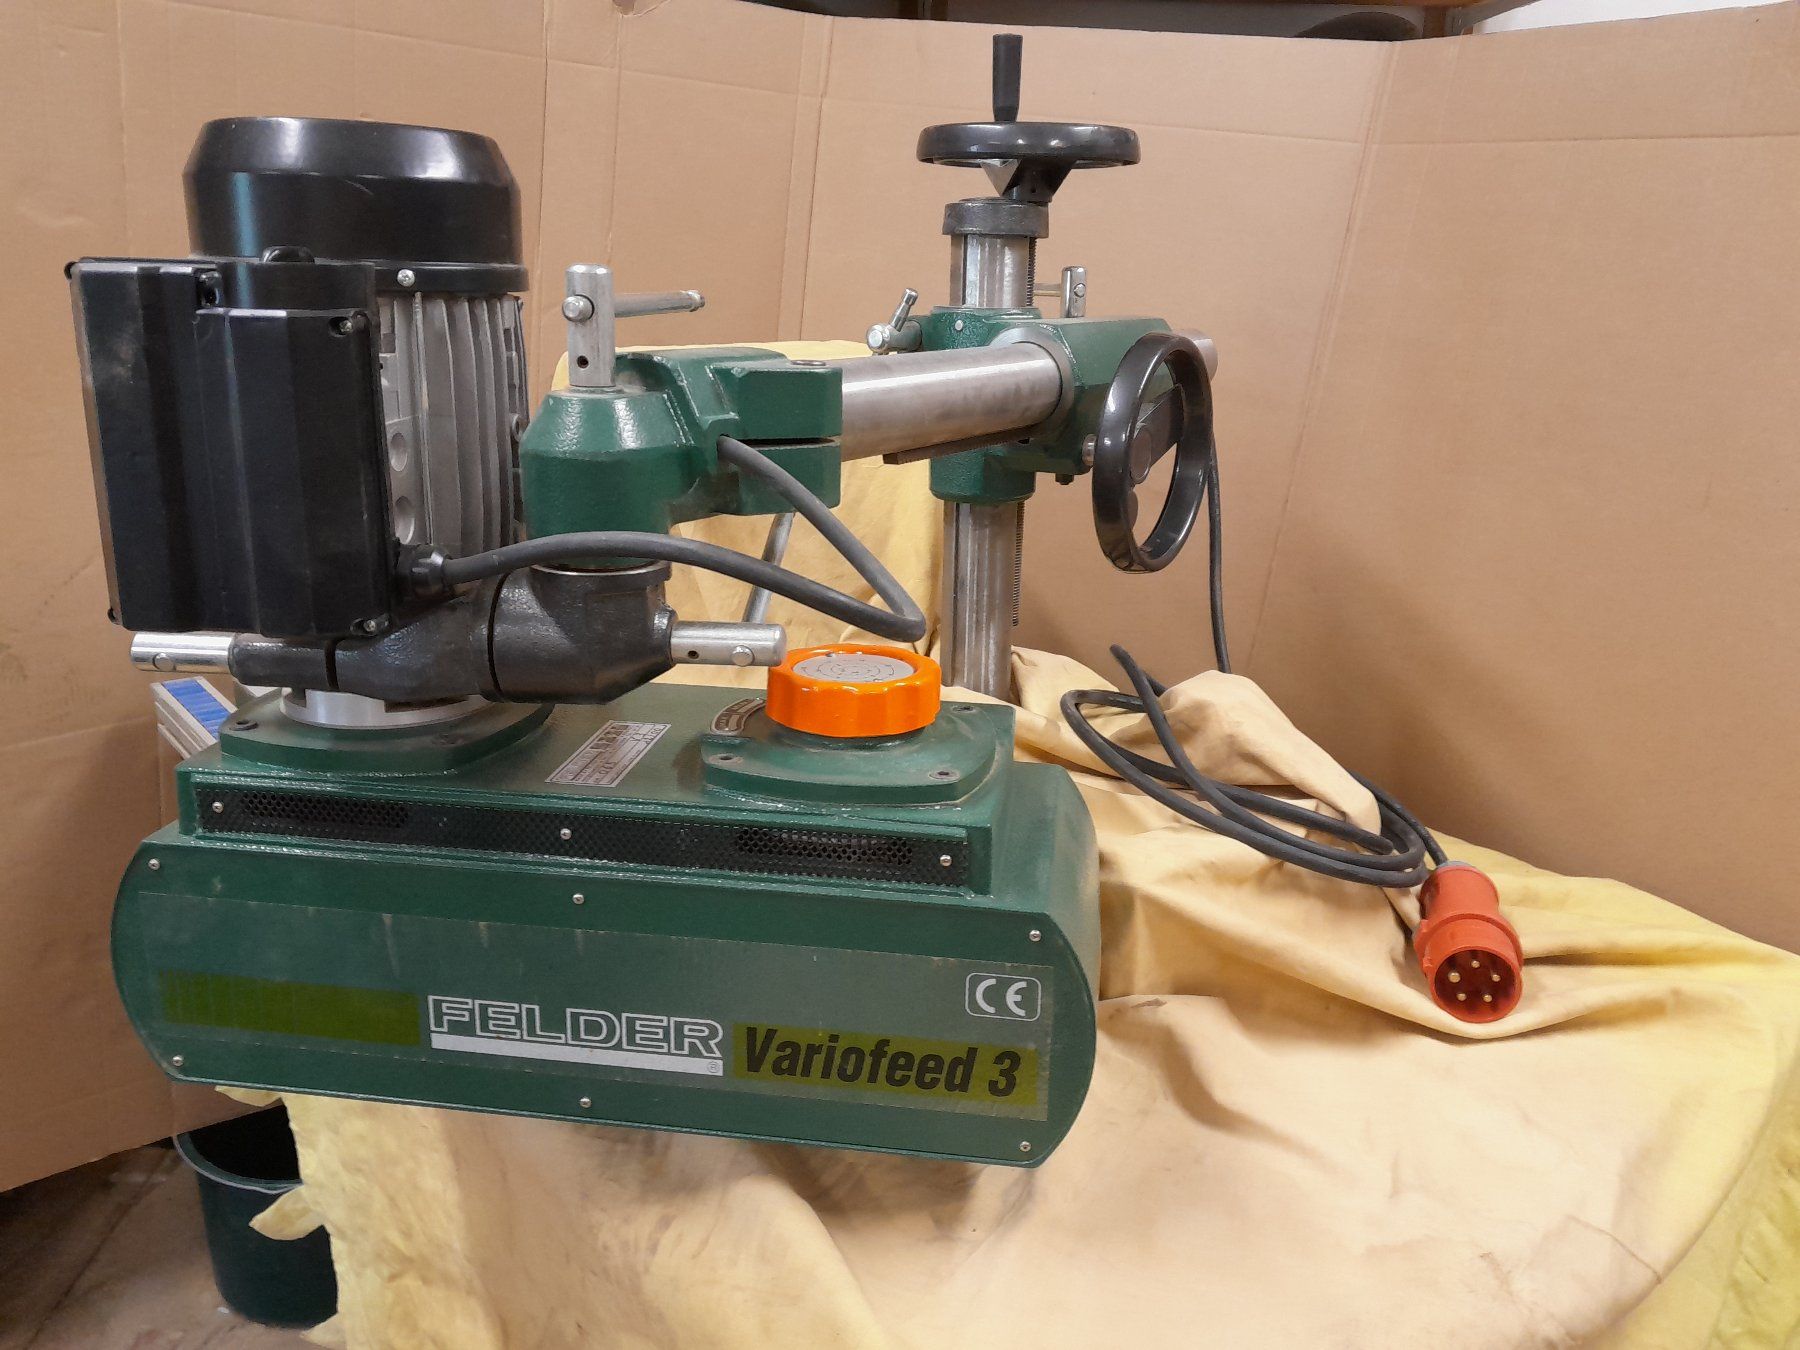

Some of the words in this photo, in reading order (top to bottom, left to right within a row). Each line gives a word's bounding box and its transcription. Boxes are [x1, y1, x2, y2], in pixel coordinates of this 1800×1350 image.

[427, 995, 723, 1058] FELDER
[975, 978, 1027, 1017] CE
[745, 1026, 978, 1093] Variofeed
[987, 1050, 1021, 1097] 3
